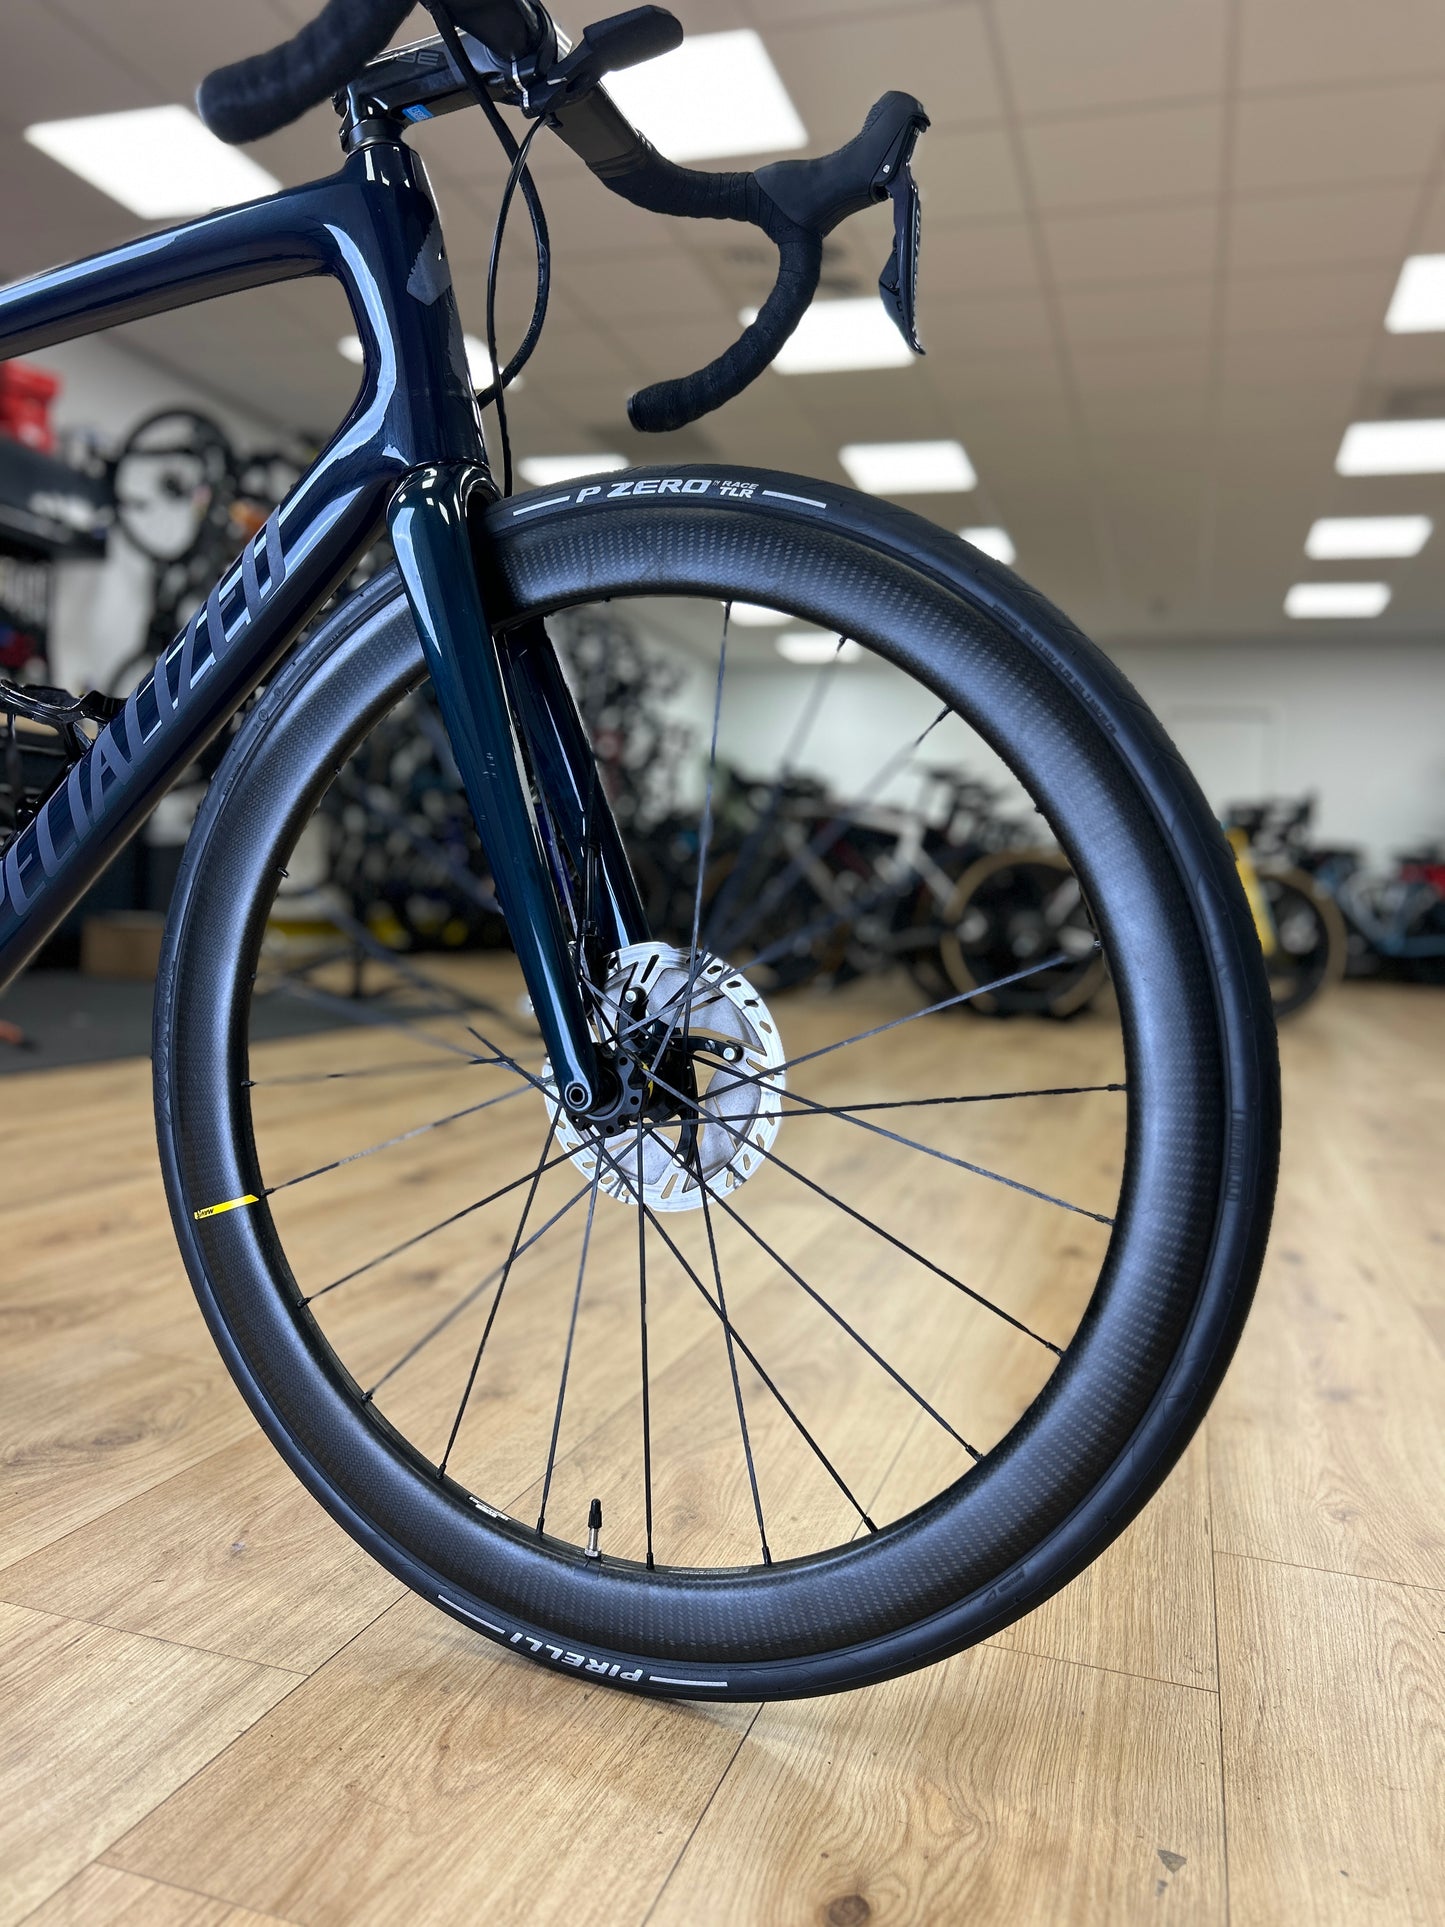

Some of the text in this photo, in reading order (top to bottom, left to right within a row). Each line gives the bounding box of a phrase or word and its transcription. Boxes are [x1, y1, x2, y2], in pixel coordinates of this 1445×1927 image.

[575, 479, 759, 504] P ZERO RACE
[719, 486, 754, 498] TLR
[0, 504, 286, 916] ECIALIZED
[509, 1632, 643, 1682] PIRELLI
